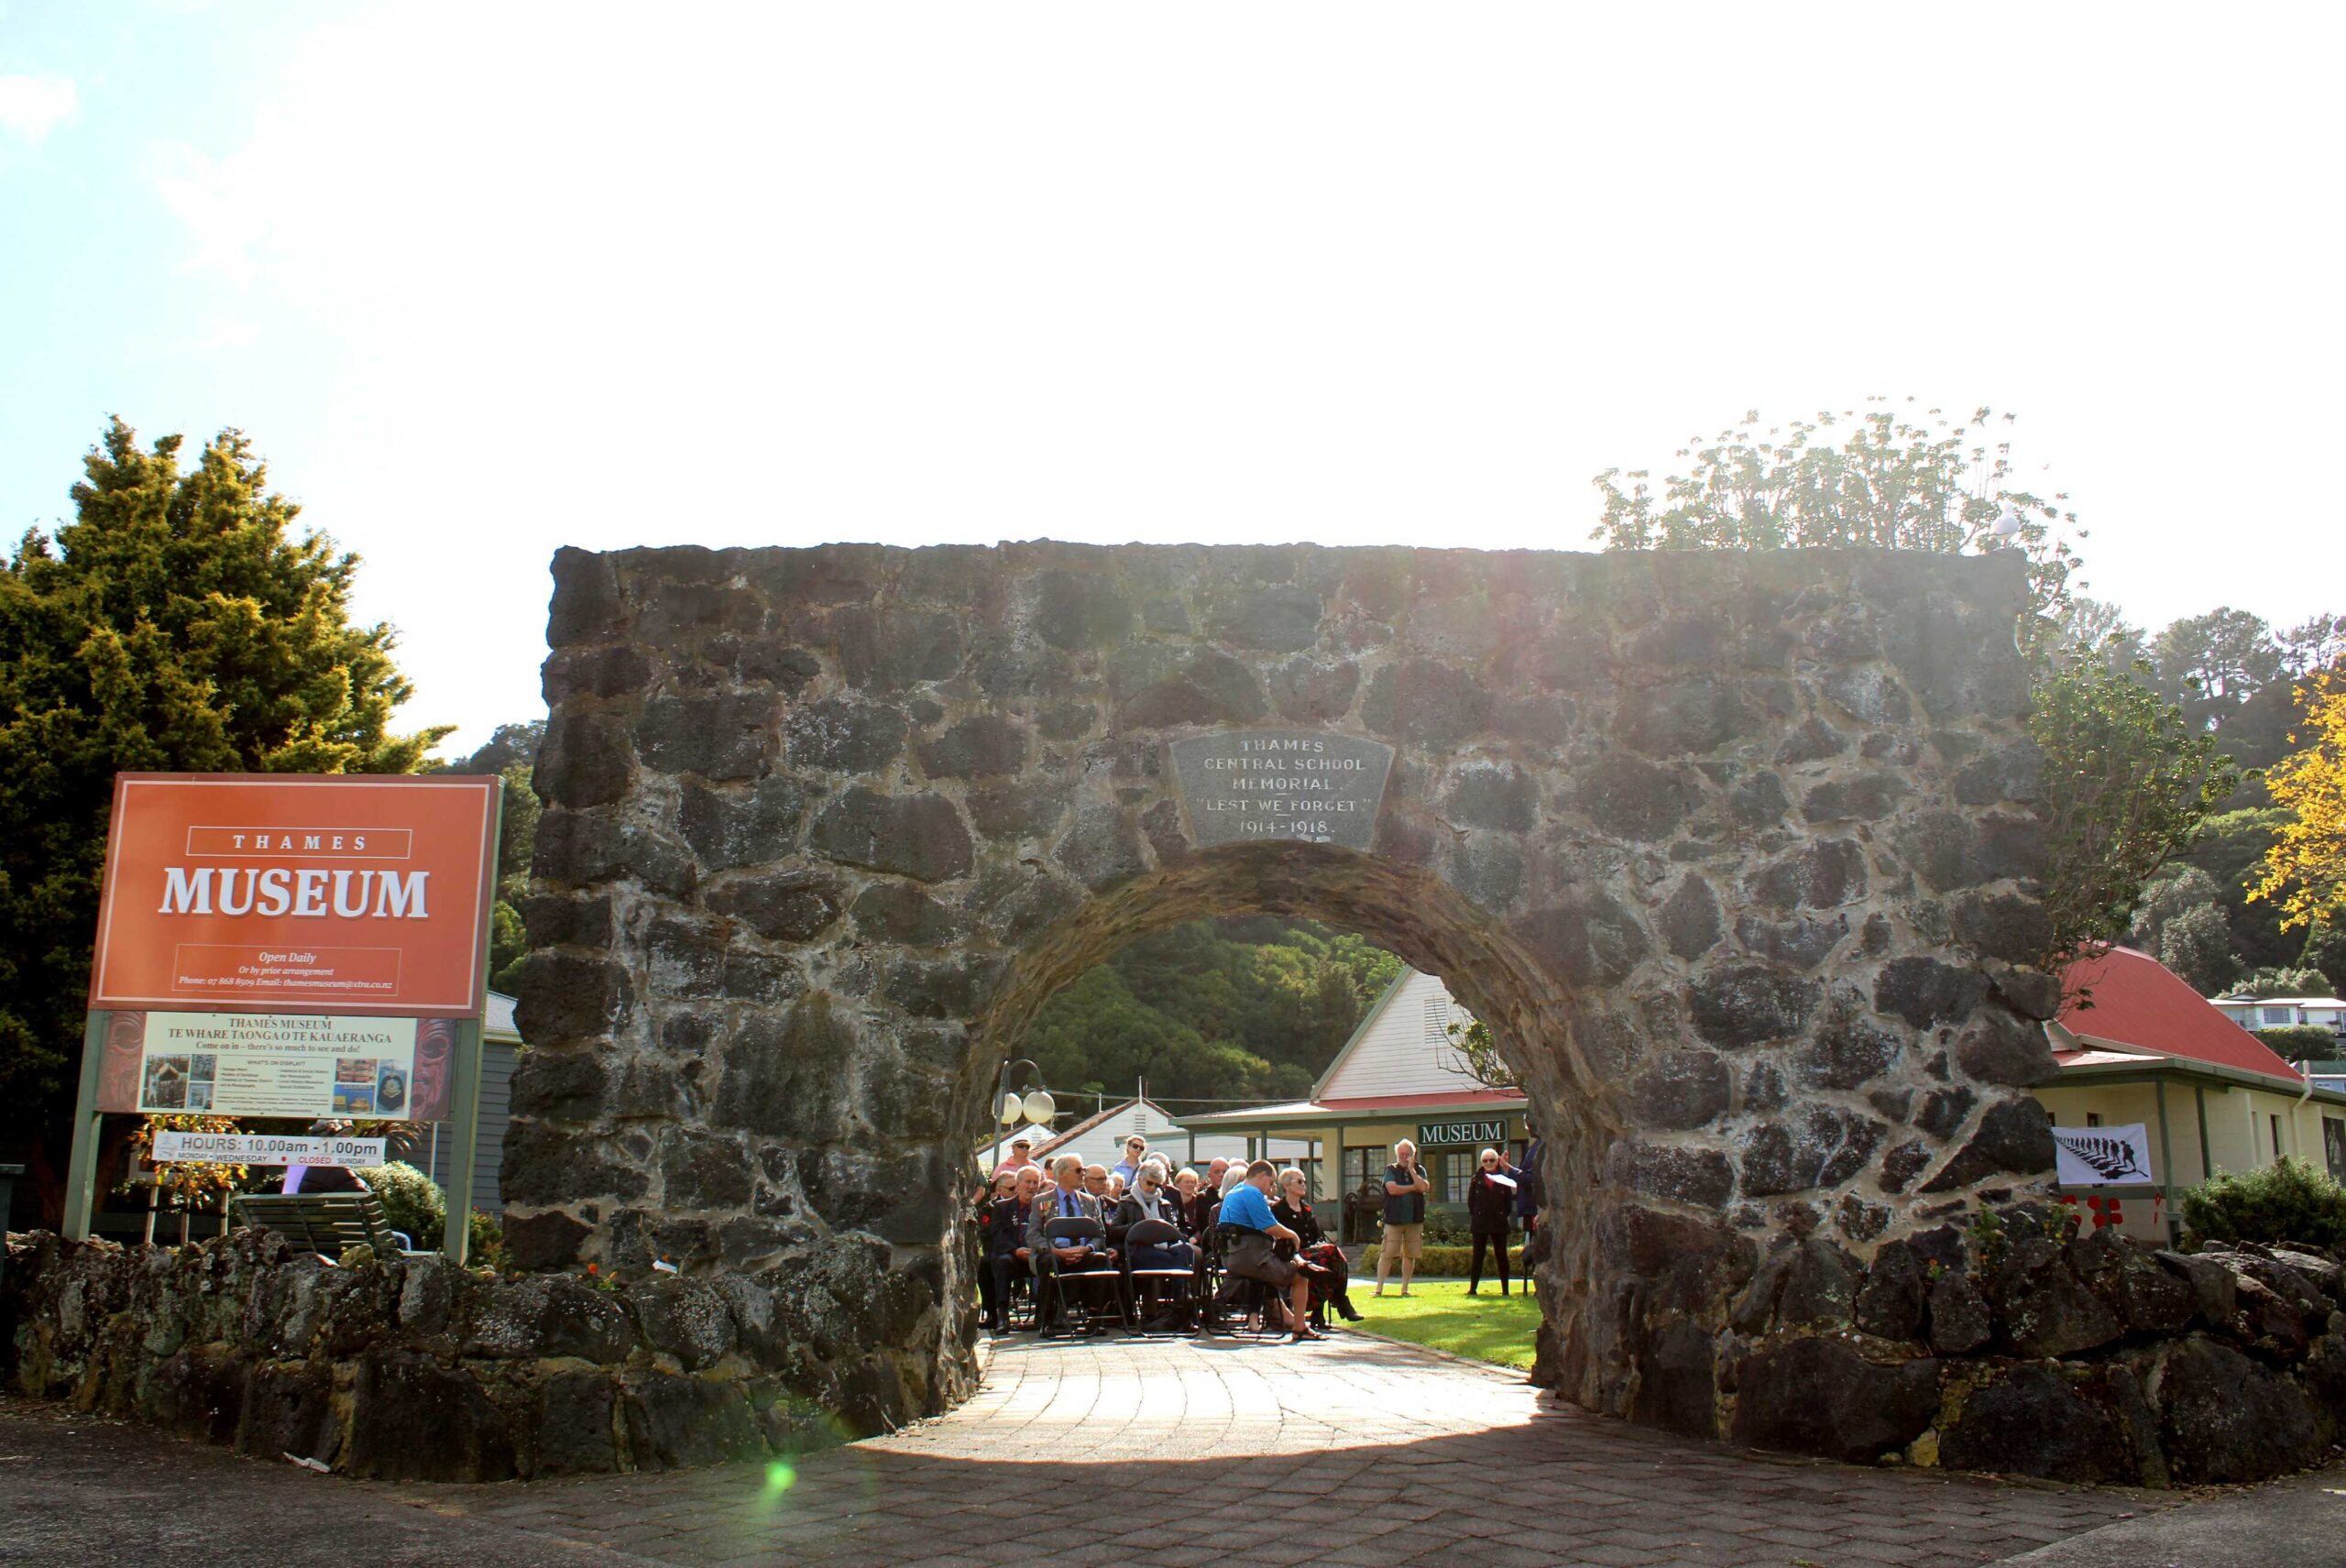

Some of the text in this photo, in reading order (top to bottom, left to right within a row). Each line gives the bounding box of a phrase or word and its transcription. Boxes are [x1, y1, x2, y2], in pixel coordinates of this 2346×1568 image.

[1241, 740, 1324, 752] THAMES
[1203, 759, 1365, 771] CENTRAL SCHOOL
[1258, 800, 1283, 812] WE
[233, 835, 367, 850] THAMES
[157, 866, 430, 918] MUSEUM
[258, 951, 317, 965] Open Daily
[238, 966, 334, 977] Or by prior arrangement
[178, 976, 206, 984] Phone:
[207, 978, 218, 986] 07
[218, 977, 235, 985] 868
[256, 978, 282, 986] Email:
[229, 1018, 332, 1030] THAMES MUSEUM
[168, 1028, 393, 1044] TE WHARE TAONGA O TE KAUAERANGA
[196, 1041, 219, 1049] Come
[285, 1044, 307, 1052] much
[331, 1045, 345, 1053] and
[1421, 1122, 1502, 1144] MUSEUM
[181, 1137, 242, 1150] HOURS:
[247, 1139, 308, 1152] 10.00am
[323, 1141, 378, 1157] 1.00pm
[215, 1154, 268, 1162] WEDNESDAY
[337, 1157, 367, 1165] SUNDAY
